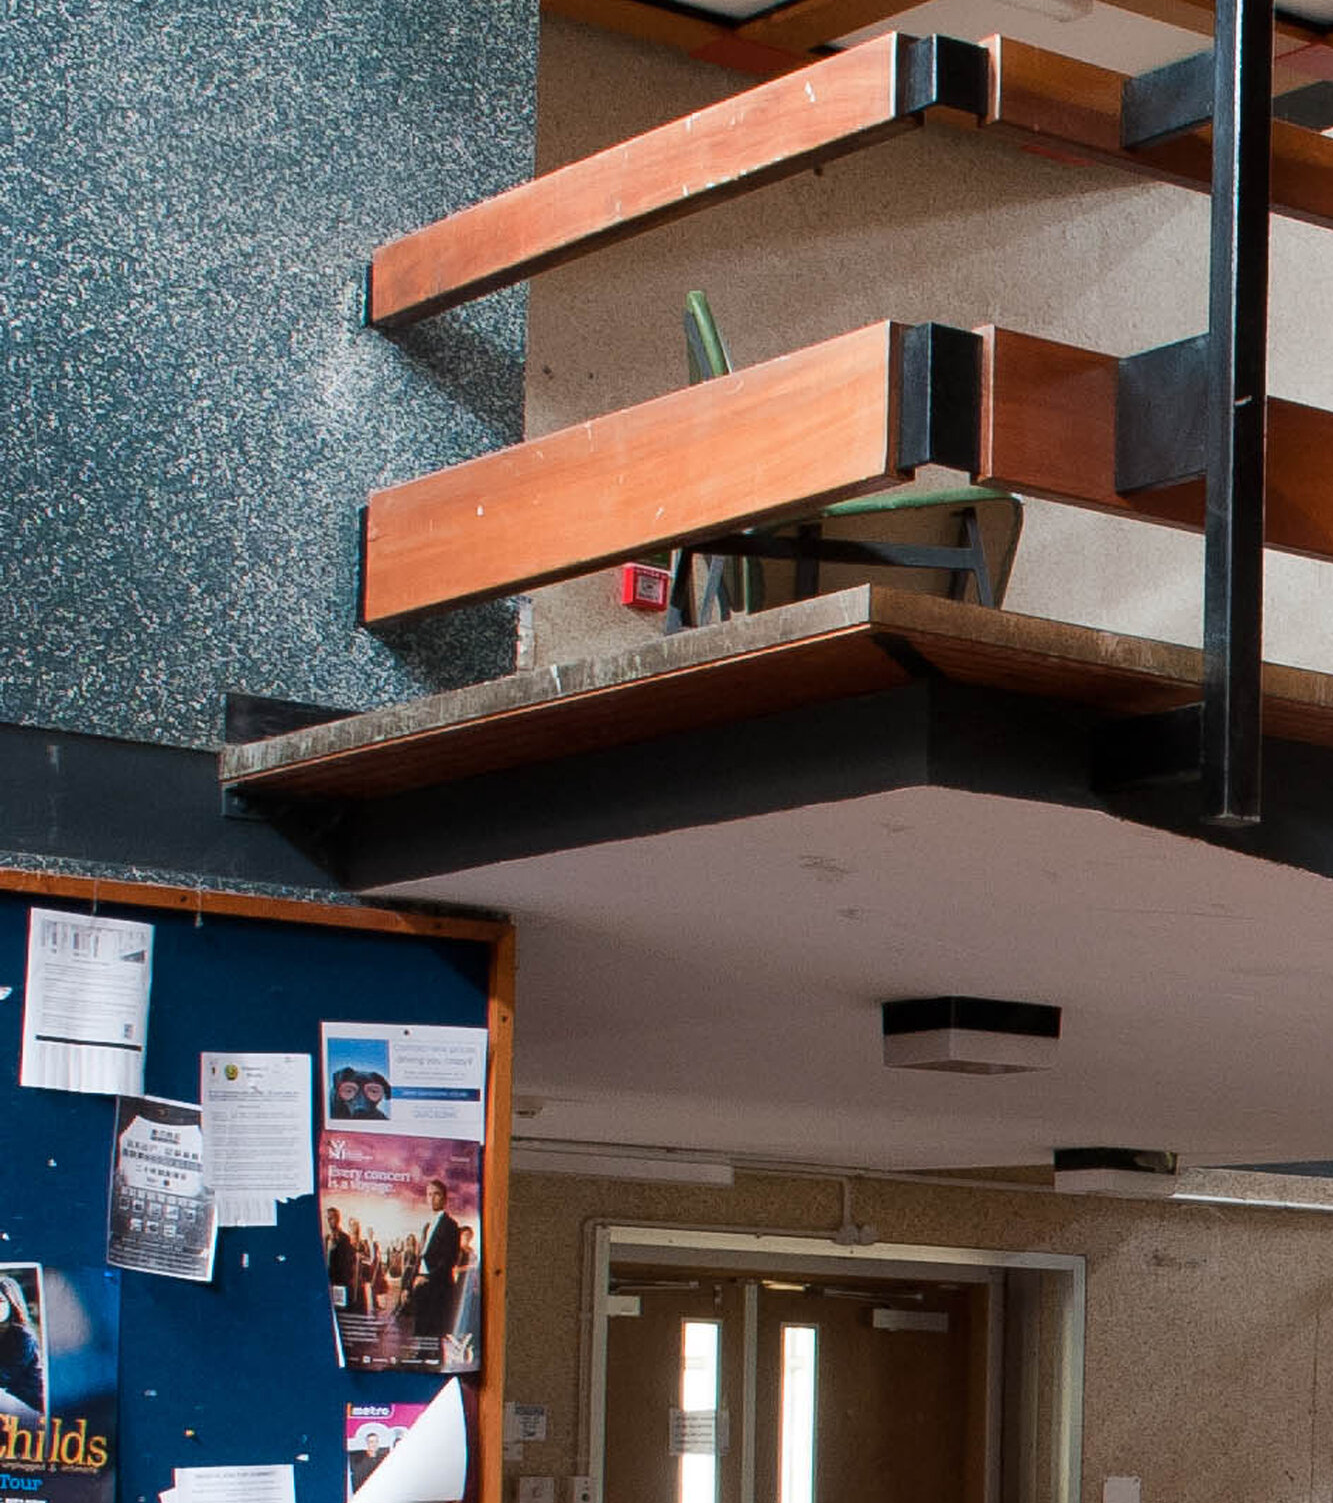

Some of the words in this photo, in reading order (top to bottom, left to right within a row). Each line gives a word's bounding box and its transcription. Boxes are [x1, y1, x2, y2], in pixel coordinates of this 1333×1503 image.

[328, 1165, 364, 1182] Every
[365, 1168, 410, 1183] concert
[351, 1405, 390, 1416] metro
[0, 1473, 43, 1492] Tour
